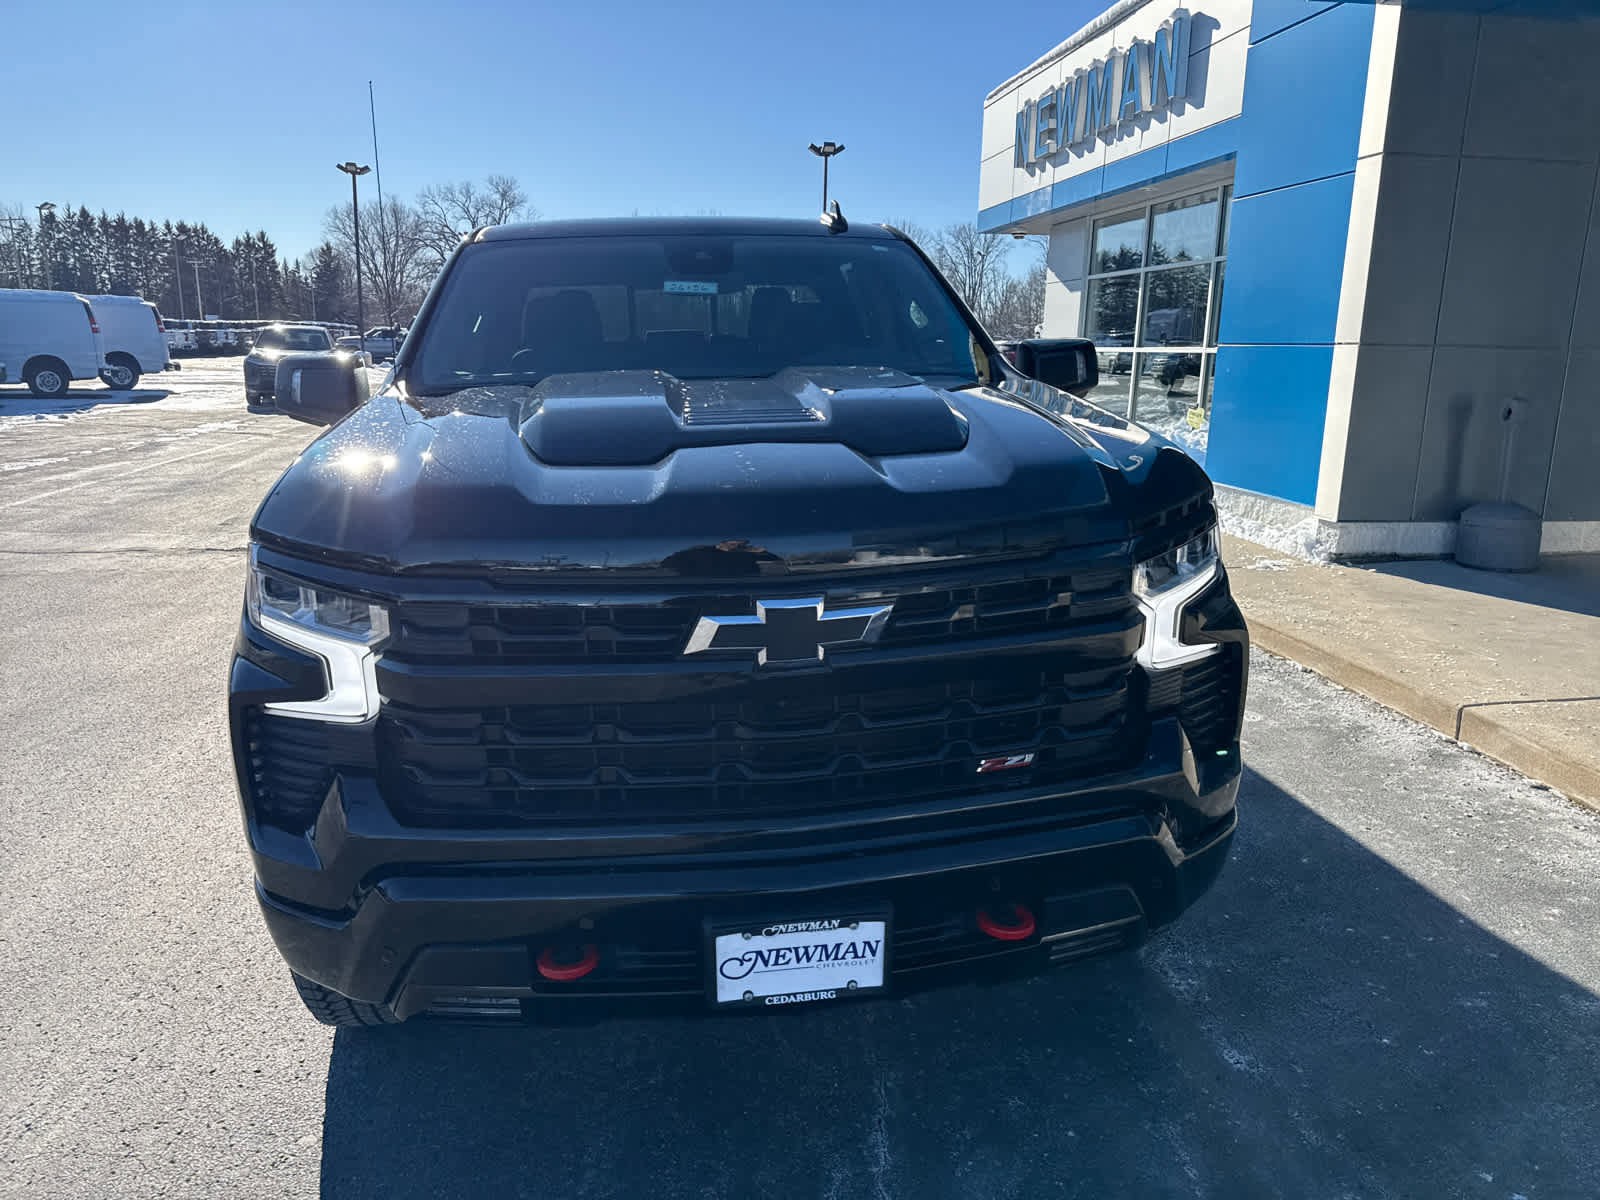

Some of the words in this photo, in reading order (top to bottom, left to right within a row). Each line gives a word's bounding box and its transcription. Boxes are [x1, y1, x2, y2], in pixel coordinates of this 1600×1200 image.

[1014, 12, 1192, 169] NEWMAN
[762, 919, 840, 937] NEWMAN
[719, 939, 881, 980] NEWMAN
[815, 958, 876, 969] CHEVROLET
[764, 990, 837, 1006] CEDARBURG
